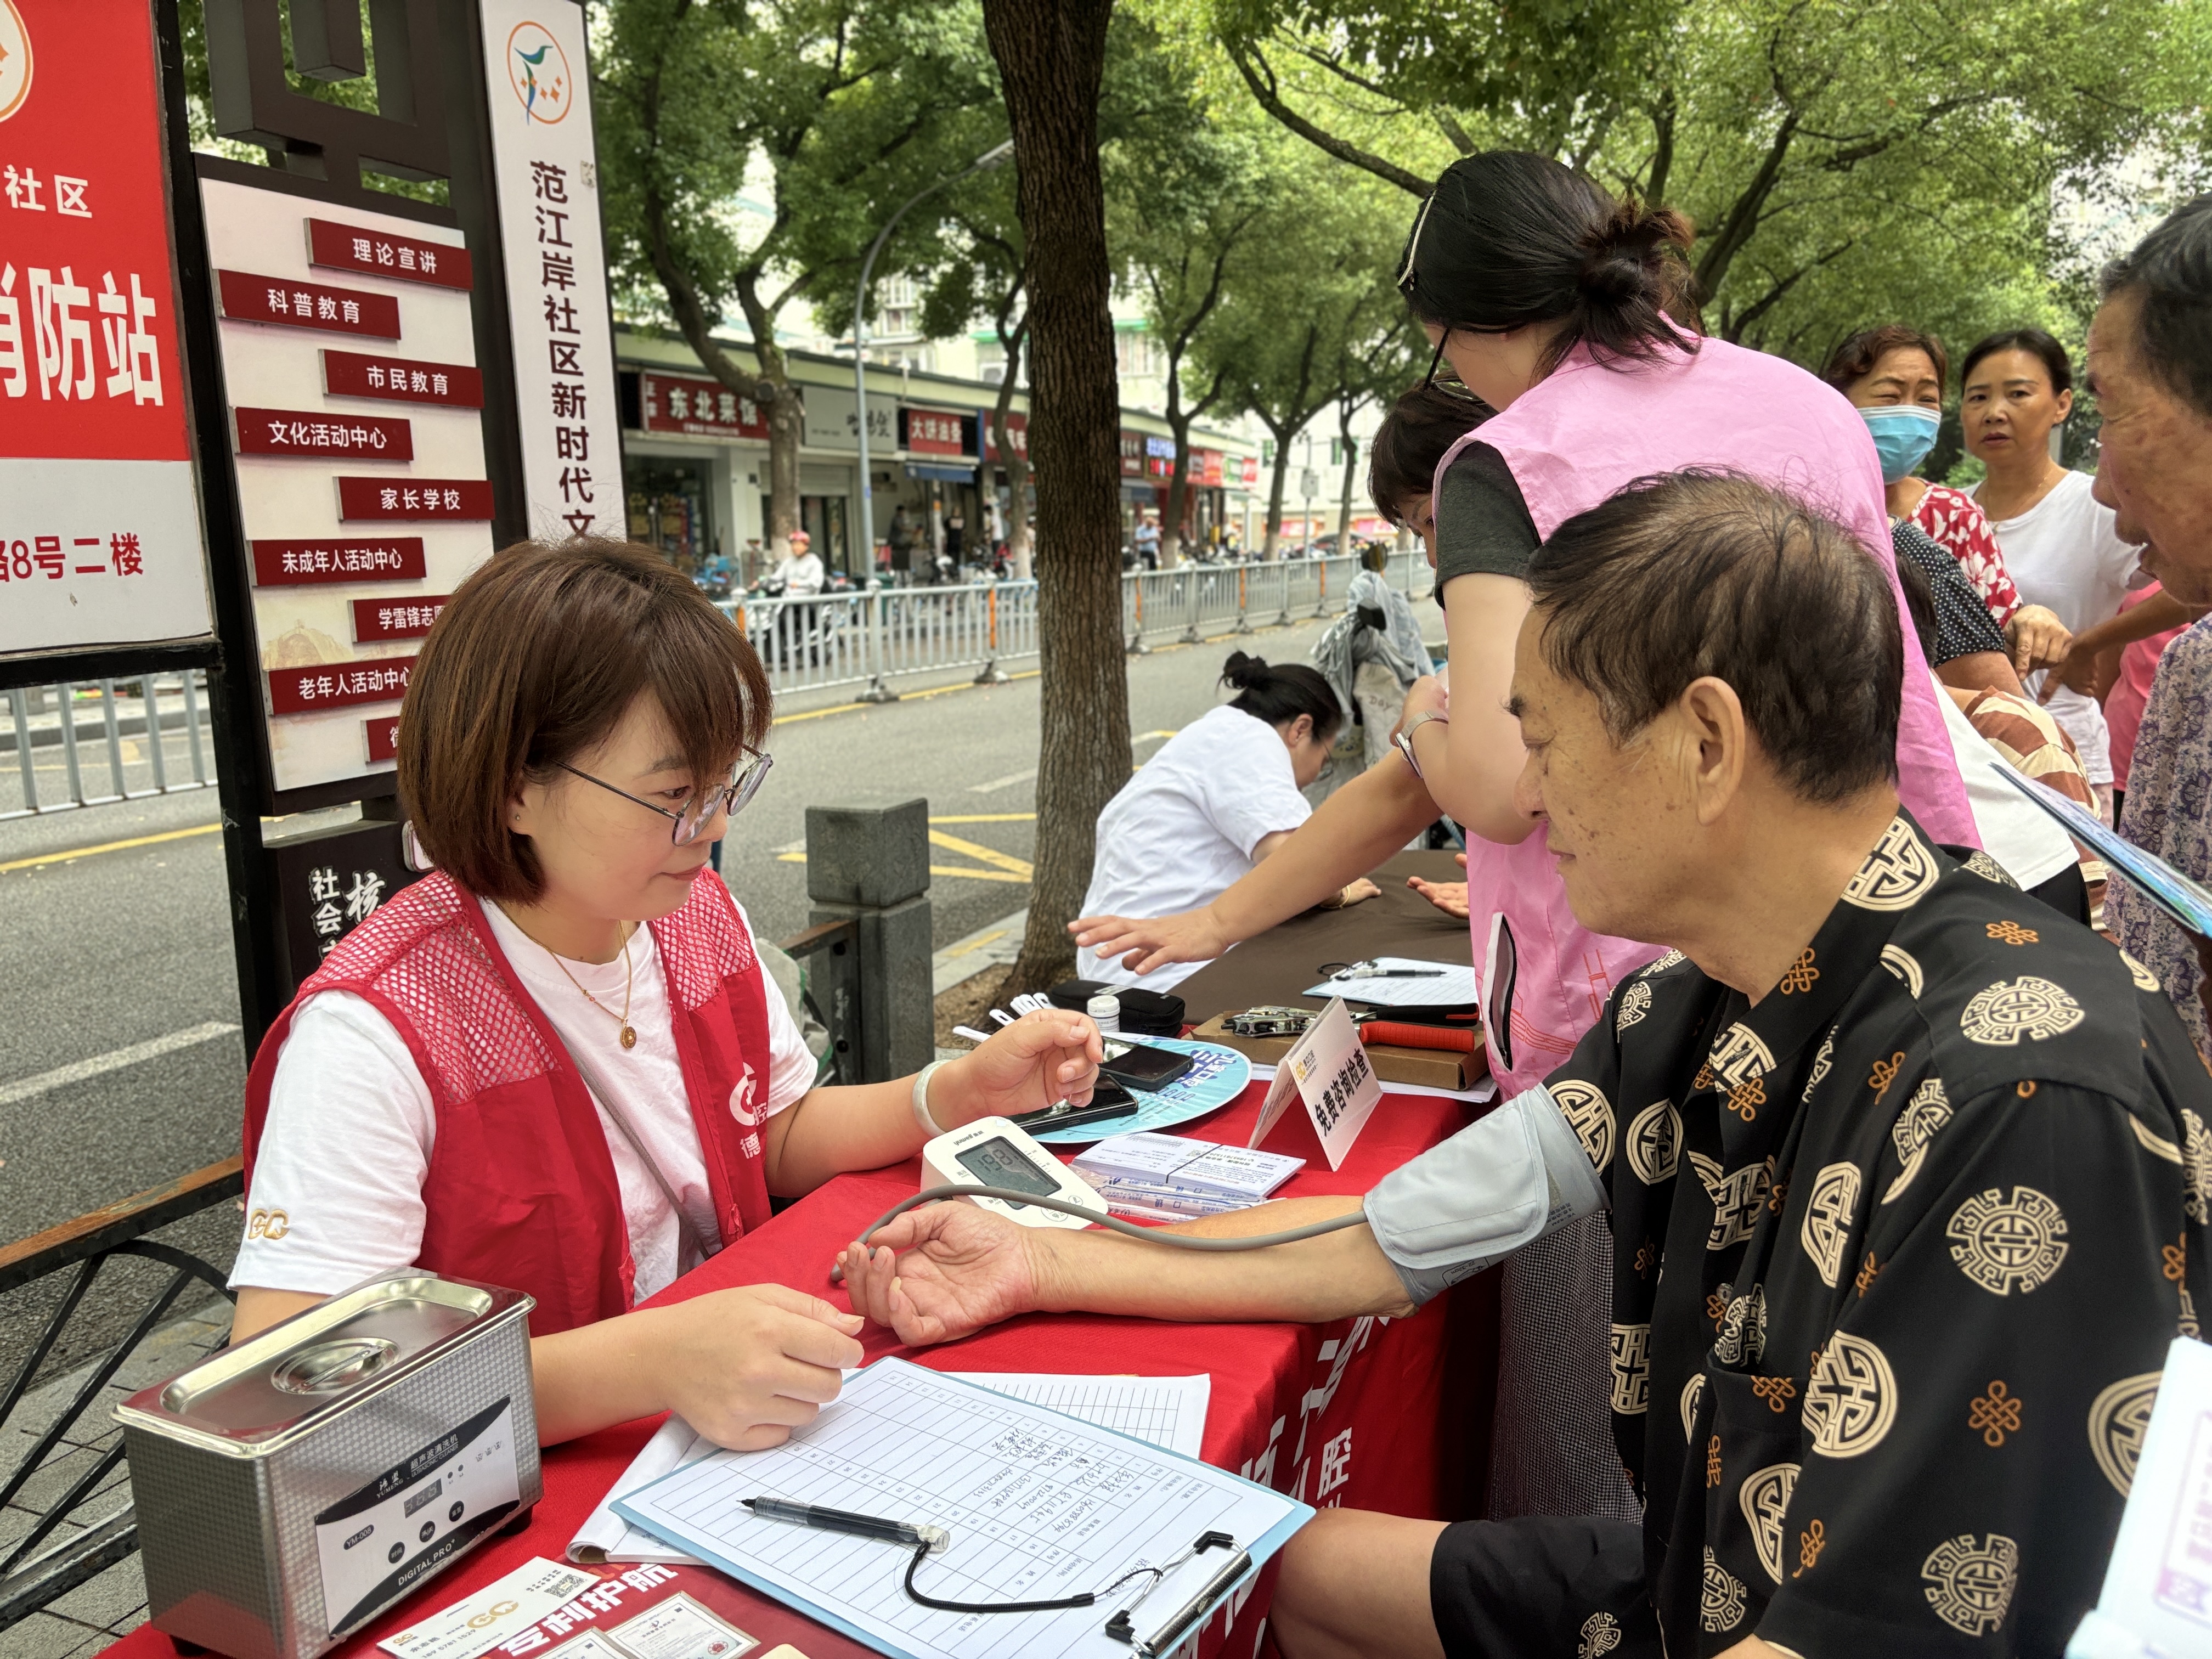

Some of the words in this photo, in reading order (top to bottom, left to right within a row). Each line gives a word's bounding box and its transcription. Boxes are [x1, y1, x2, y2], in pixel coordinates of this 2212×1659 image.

[4, 164, 92, 218] 社区
[353, 238, 437, 274] 理论宣讲
[267, 289, 360, 324] 科普教育
[530, 159, 595, 535] 范江岸社区新时代文
[366, 366, 448, 395] 市民教育
[669, 387, 757, 426] 东北菜馆
[268, 420, 387, 449] 文化活动中心
[381, 488, 461, 510] 家长学校
[282, 548, 403, 574] 未成年人活动中心
[1314, 1048, 1369, 1137] 免费咨询检查
[953, 1134, 973, 1146] yuwell
[410, 1433, 459, 1469] 超声波清洗机
[411, 1456, 438, 1478] ULTRASONIC
[439, 1443, 459, 1460] CLEANER
[376, 1479, 404, 1499] YUMENG
[346, 1525, 373, 1547] YM-008
[398, 1559, 432, 1587] DIGITAL
